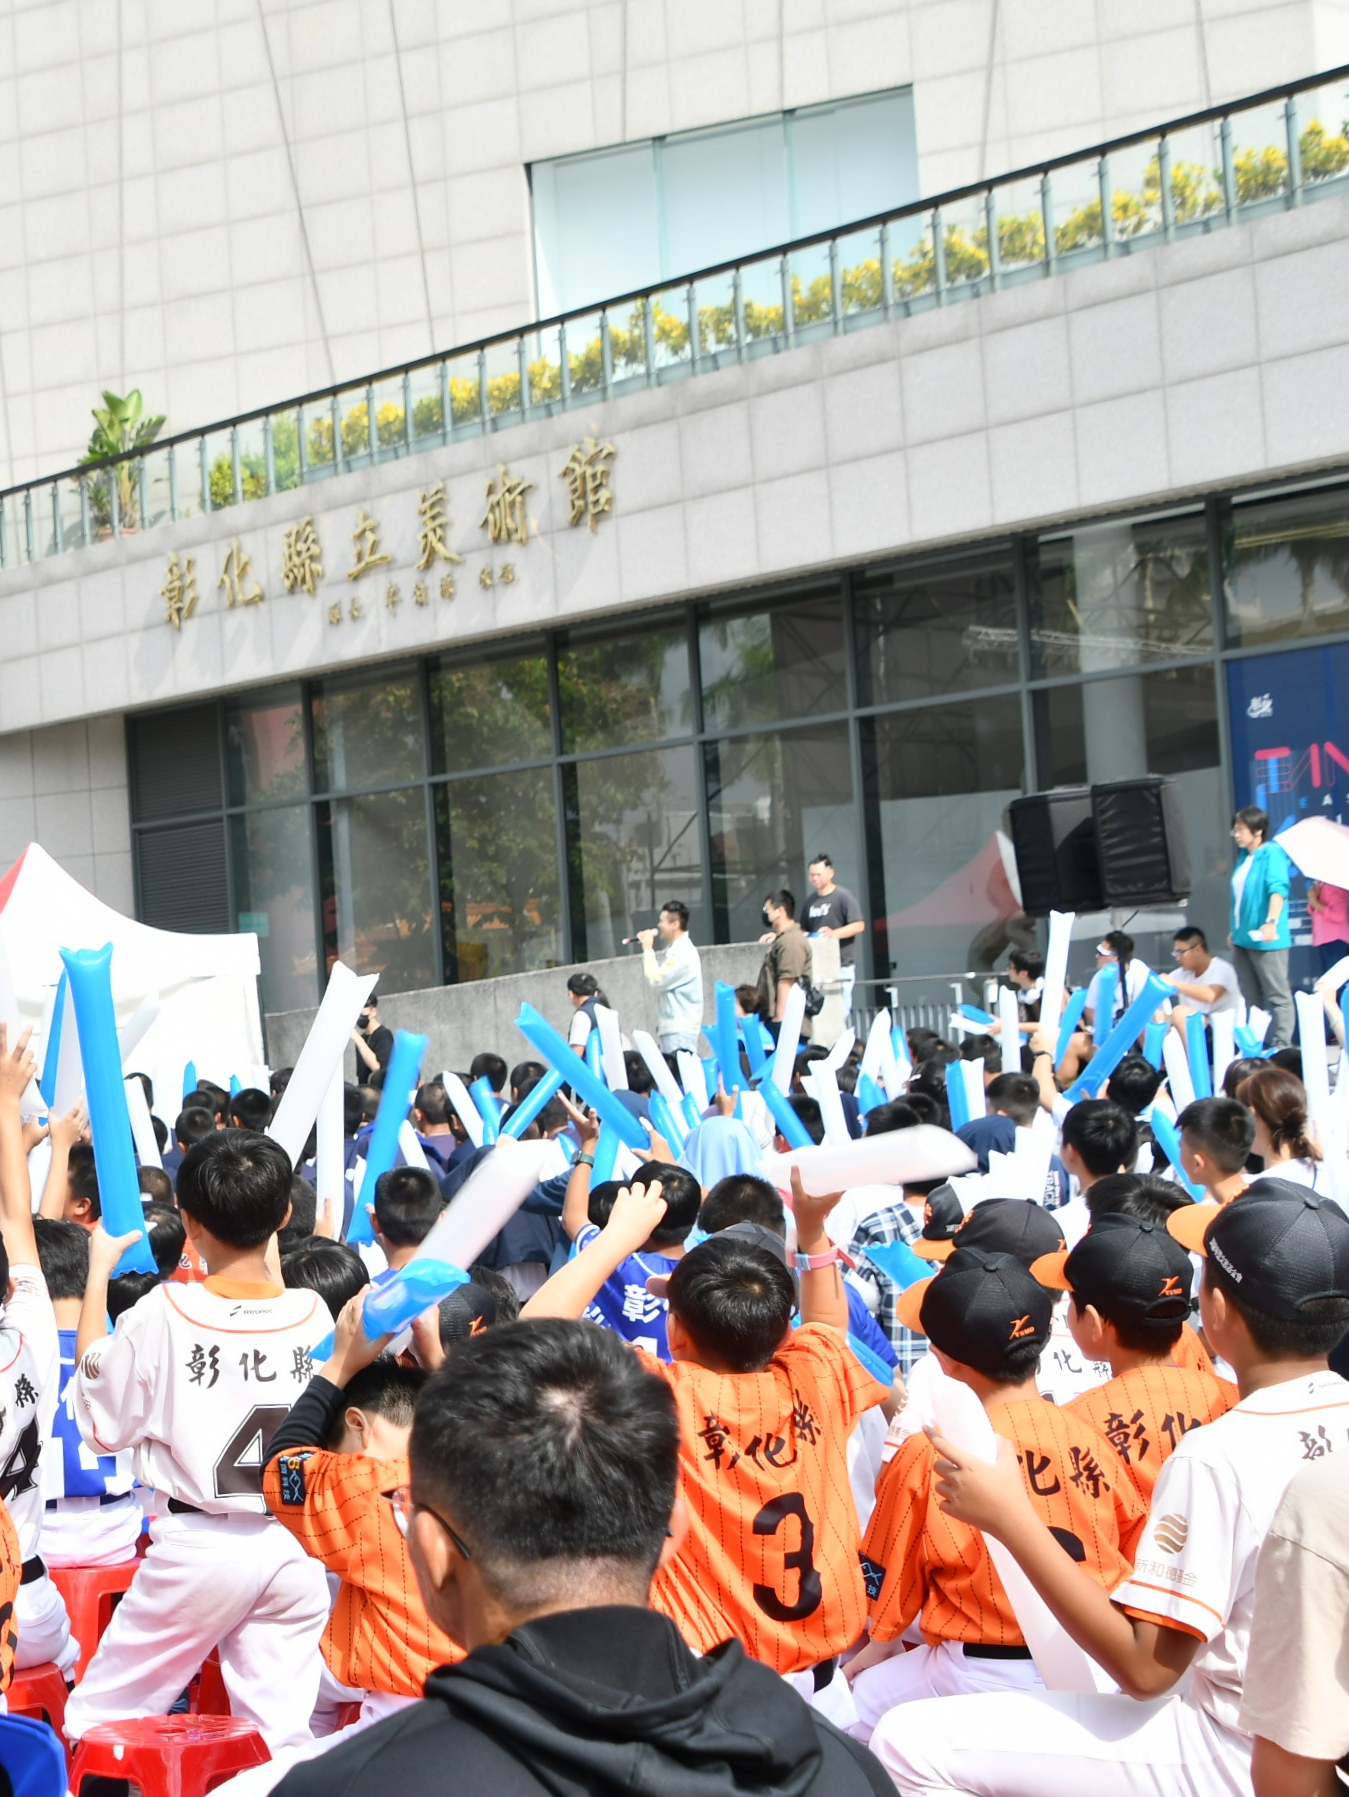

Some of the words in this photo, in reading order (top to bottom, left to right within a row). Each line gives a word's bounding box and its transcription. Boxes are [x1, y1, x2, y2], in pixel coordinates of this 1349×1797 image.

[160, 436, 616, 630] 彰化縣立美術館
[185, 1343, 314, 1389] 彰化縣
[213, 1403, 292, 1517] 4
[753, 1492, 822, 1622] 3
